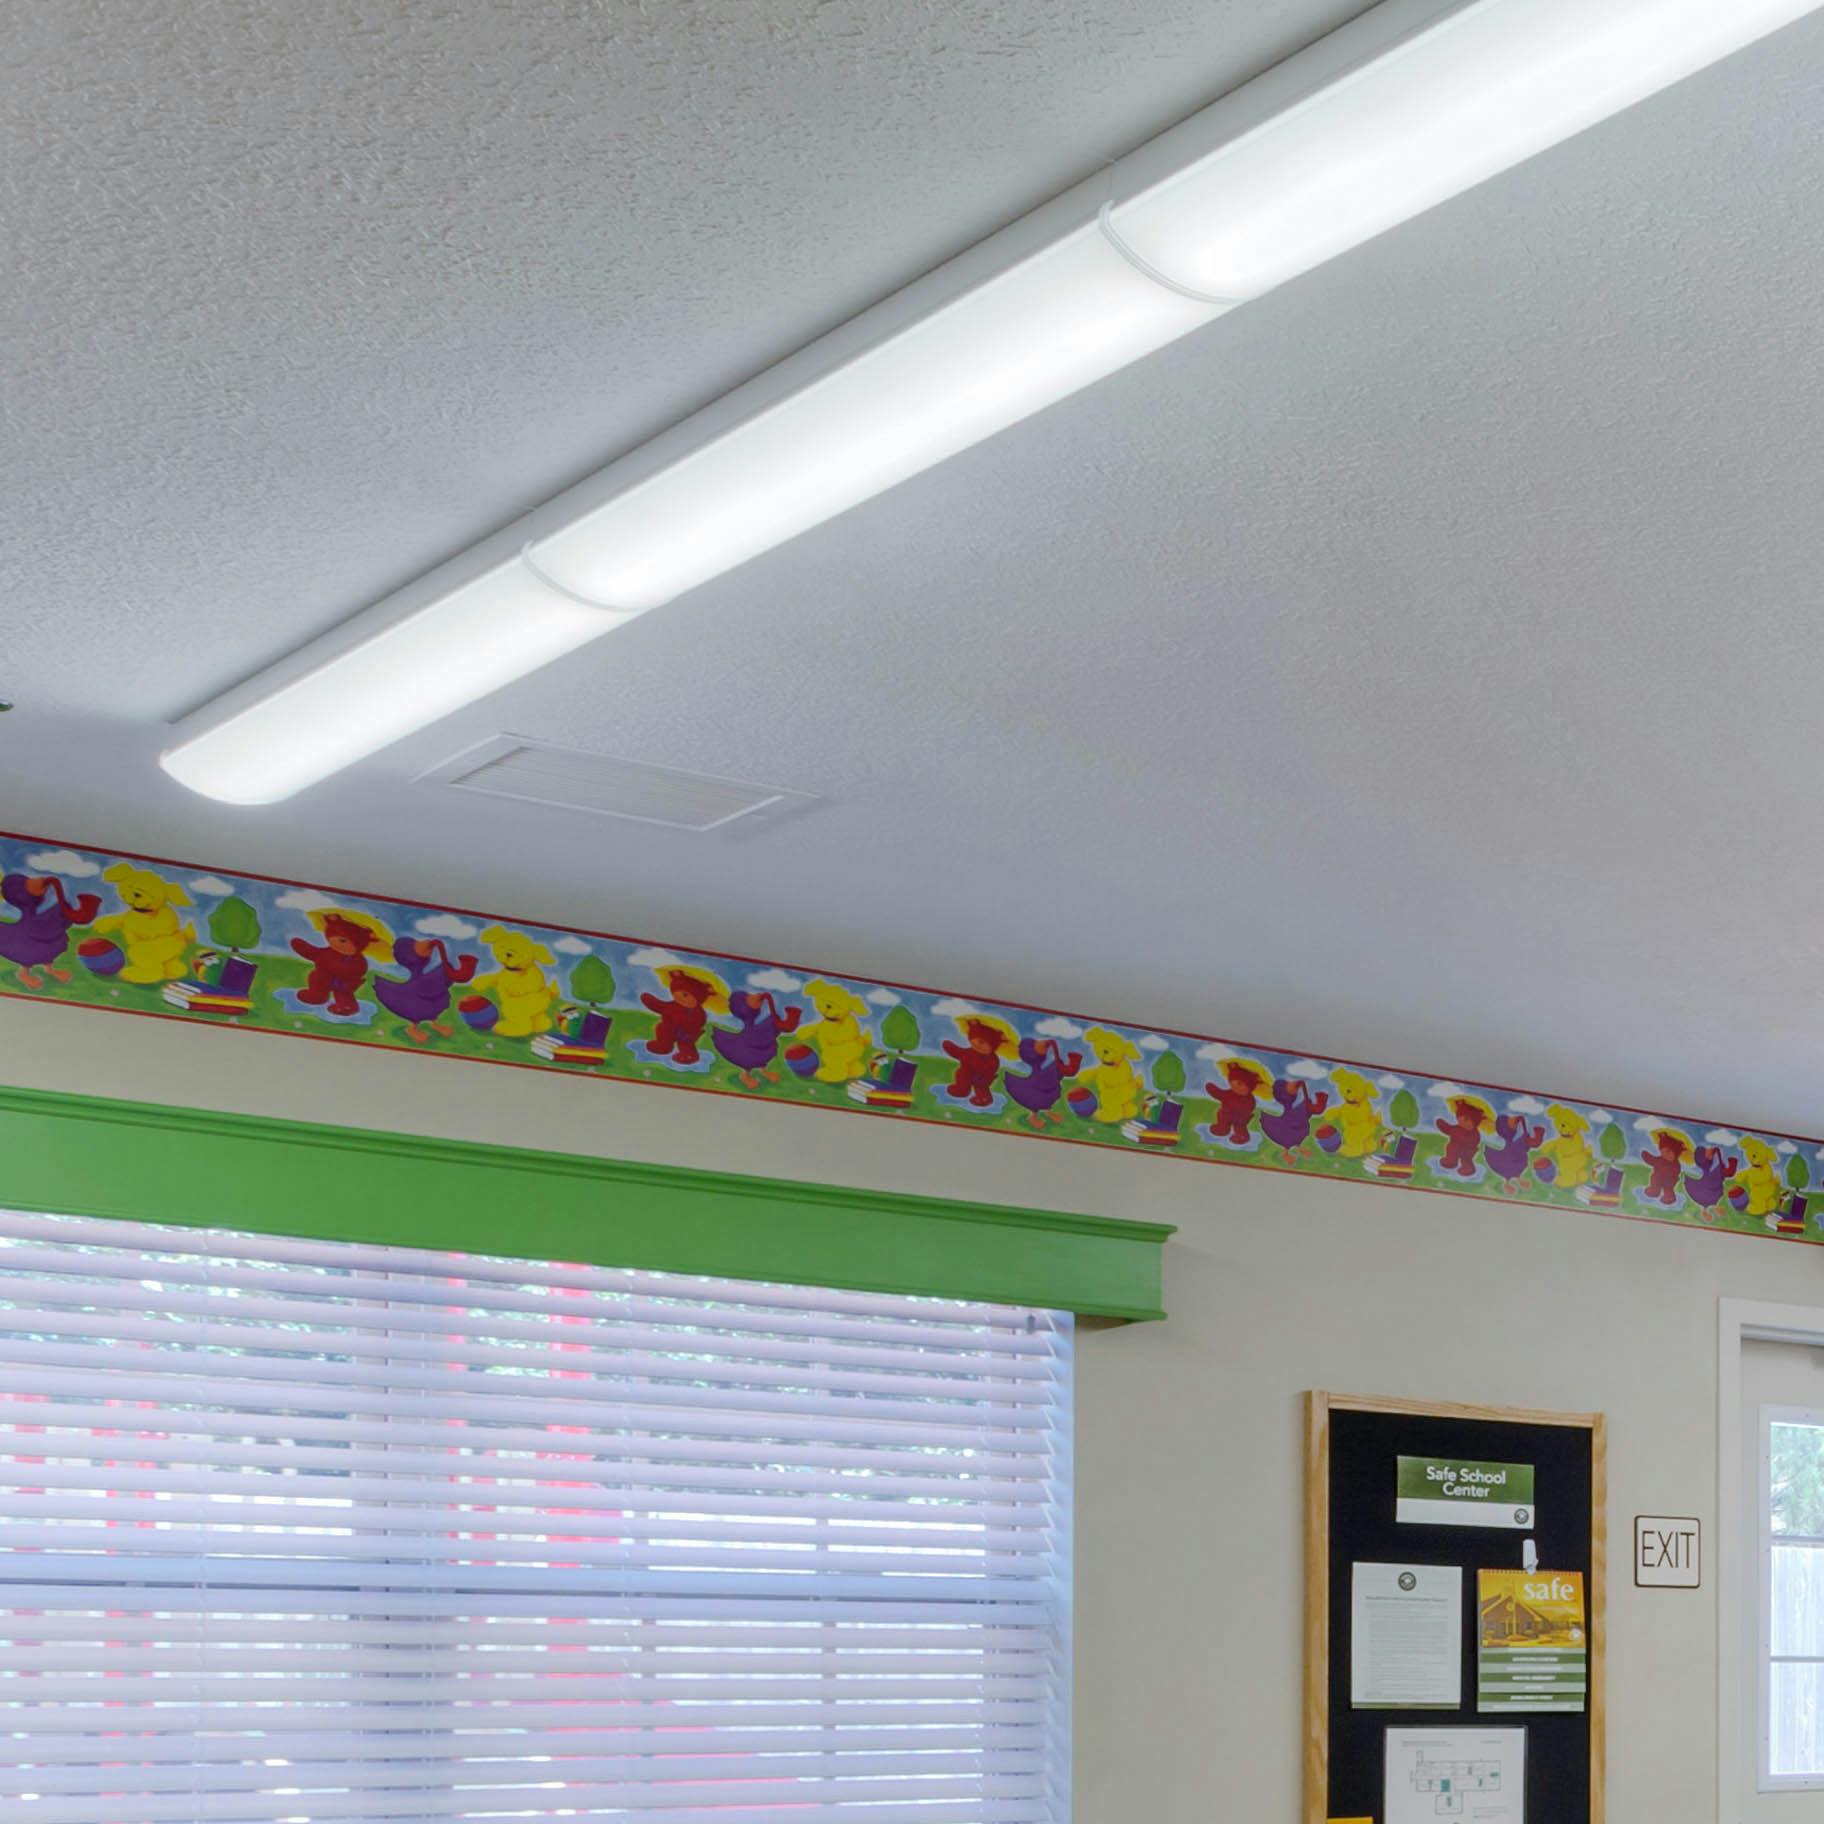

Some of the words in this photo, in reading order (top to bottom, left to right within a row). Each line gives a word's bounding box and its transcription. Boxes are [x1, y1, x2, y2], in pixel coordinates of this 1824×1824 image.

[1426, 1465, 1457, 1482] Safe
[1459, 1468, 1506, 1486] School
[1442, 1481, 1490, 1498] Center
[1640, 1530, 1696, 1571] EXIT
[1523, 1576, 1575, 1601] safe
